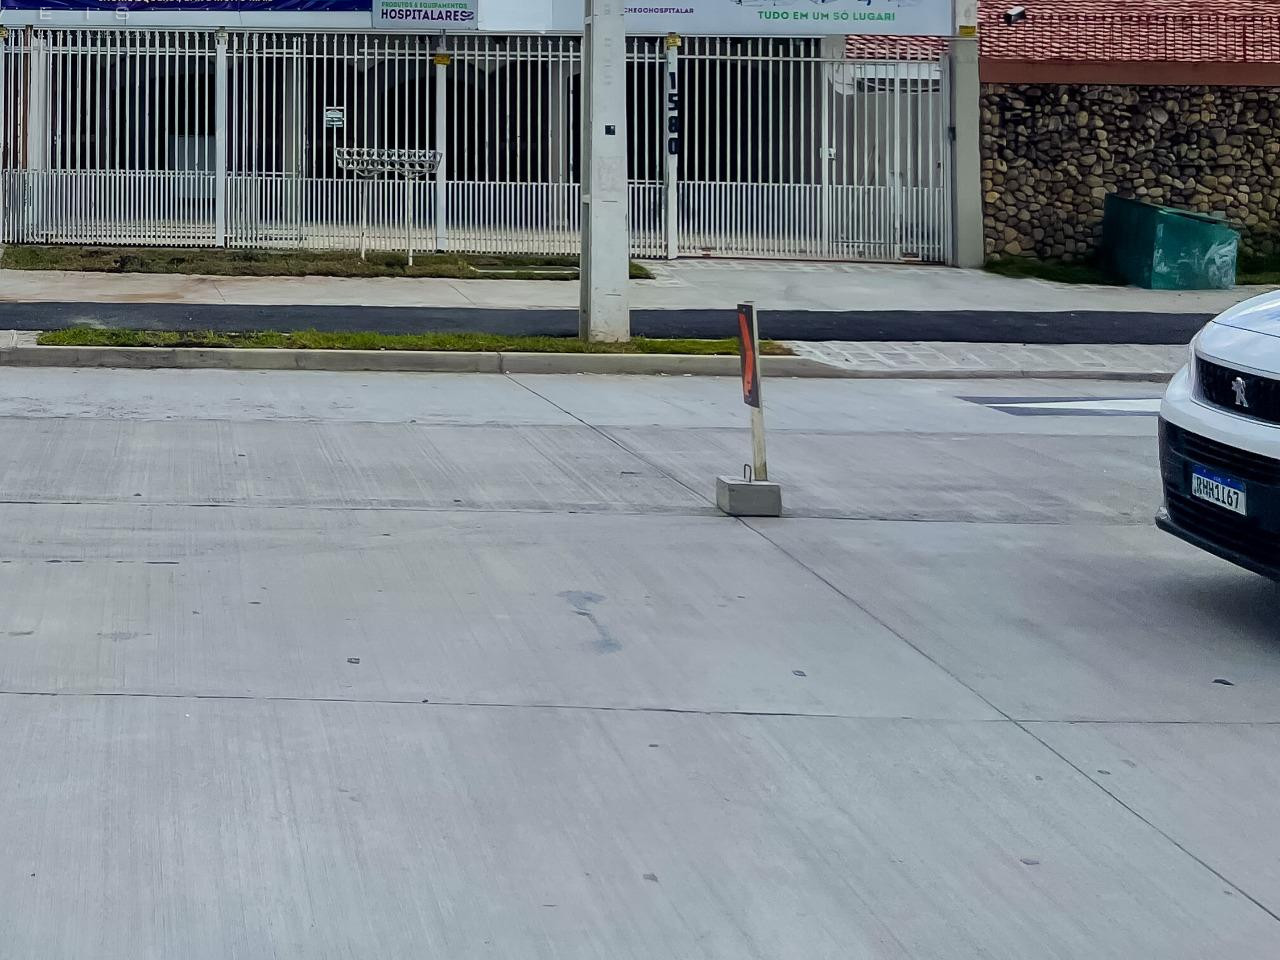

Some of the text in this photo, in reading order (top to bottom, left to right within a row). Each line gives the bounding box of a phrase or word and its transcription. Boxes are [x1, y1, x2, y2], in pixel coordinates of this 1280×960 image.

[381, 8, 473, 21] HOSPITALARES
[757, 10, 790, 20] TUDO
[793, 11, 809, 20] EM
[812, 12, 829, 21] UM
[833, 9, 849, 21] SÓ
[668, 71, 679, 155] 1580
